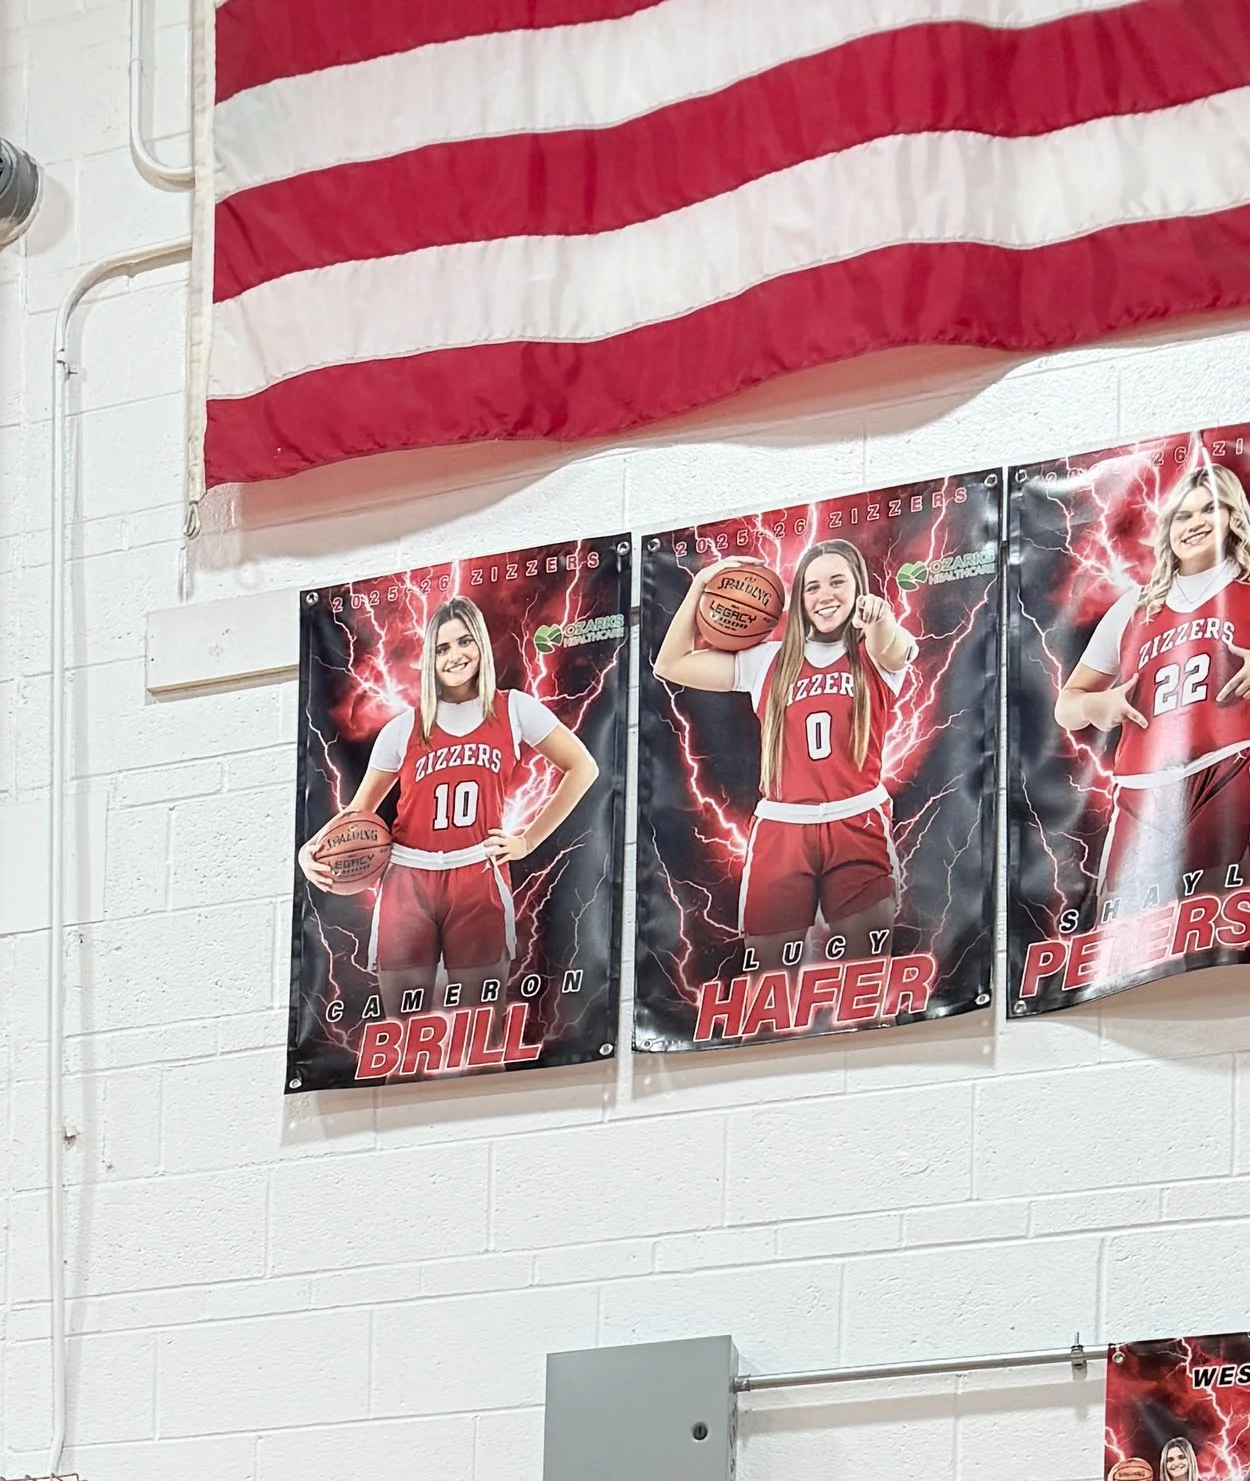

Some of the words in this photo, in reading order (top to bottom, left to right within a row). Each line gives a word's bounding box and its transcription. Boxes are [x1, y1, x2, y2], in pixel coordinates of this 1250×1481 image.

[676, 517, 807, 558] 2025-26
[829, 487, 968, 529] ZIZZERS
[332, 574, 452, 614] 2025-26
[470, 551, 600, 587] ZIZZERS
[930, 549, 996, 574] OZARKS
[709, 600, 758, 624] LEGACY
[717, 577, 772, 608] SPALDING
[564, 613, 625, 638] OZARKS
[1137, 617, 1235, 671] ZIZZERS
[786, 671, 856, 708] IZZER
[1152, 652, 1211, 718] 22
[805, 710, 832, 761] 0
[415, 743, 502, 783] ZIZZERS
[432, 779, 479, 831] 10
[326, 829, 379, 851] SPALDING
[742, 929, 890, 972] LUCY
[1018, 889, 1250, 999] PETERS
[325, 969, 584, 1023] CAMERON
[693, 953, 938, 1043] HAFER
[353, 1002, 544, 1081] BRILL
[1192, 1363, 1250, 1390] WES
